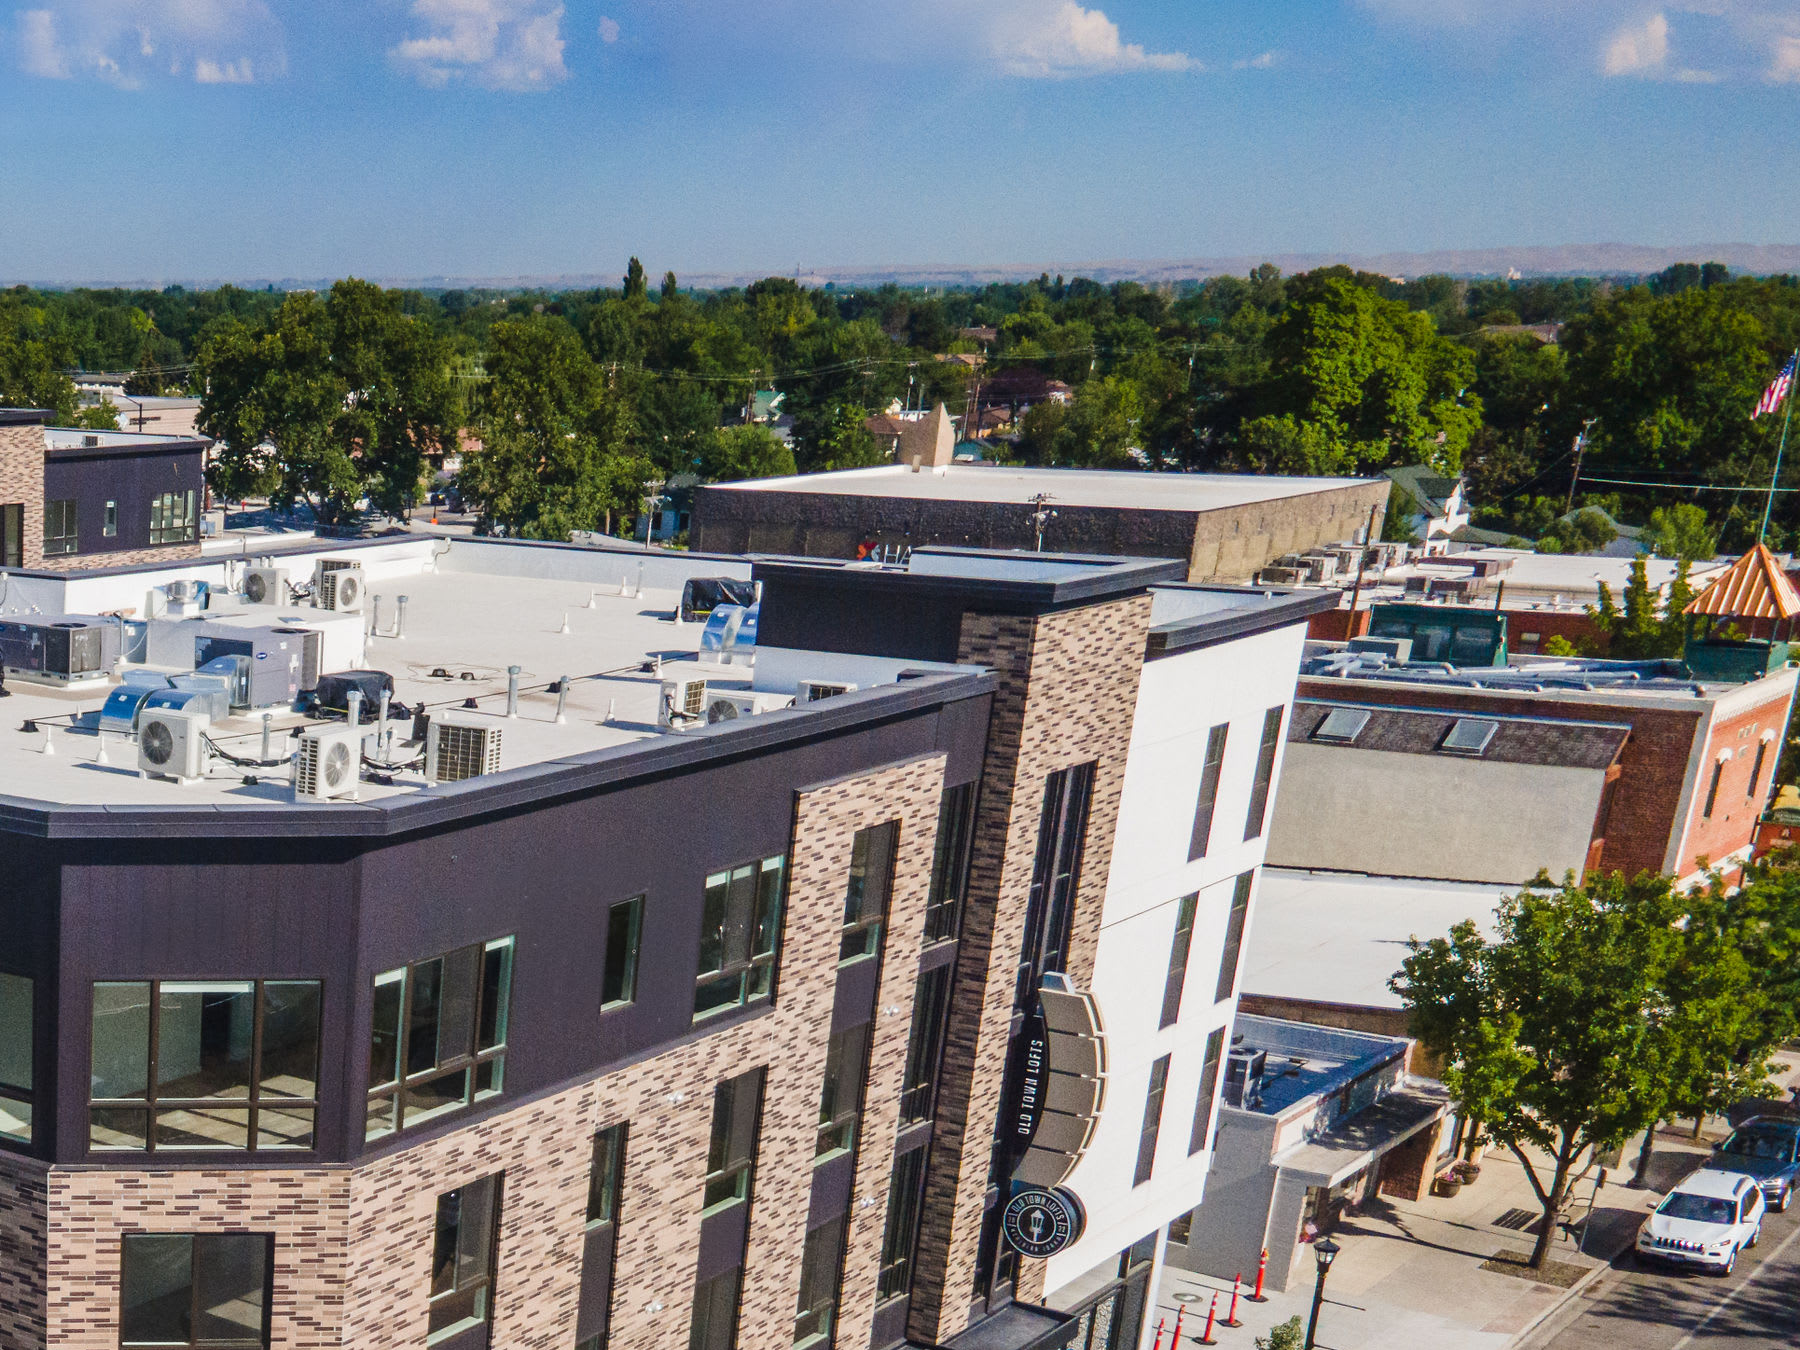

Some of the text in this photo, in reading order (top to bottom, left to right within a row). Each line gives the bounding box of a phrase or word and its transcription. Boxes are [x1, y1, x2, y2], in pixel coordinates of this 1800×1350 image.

[1018, 1040, 1043, 1135] OLD TOWN LOFTS
[1046, 1200, 1065, 1220] LOFTS
